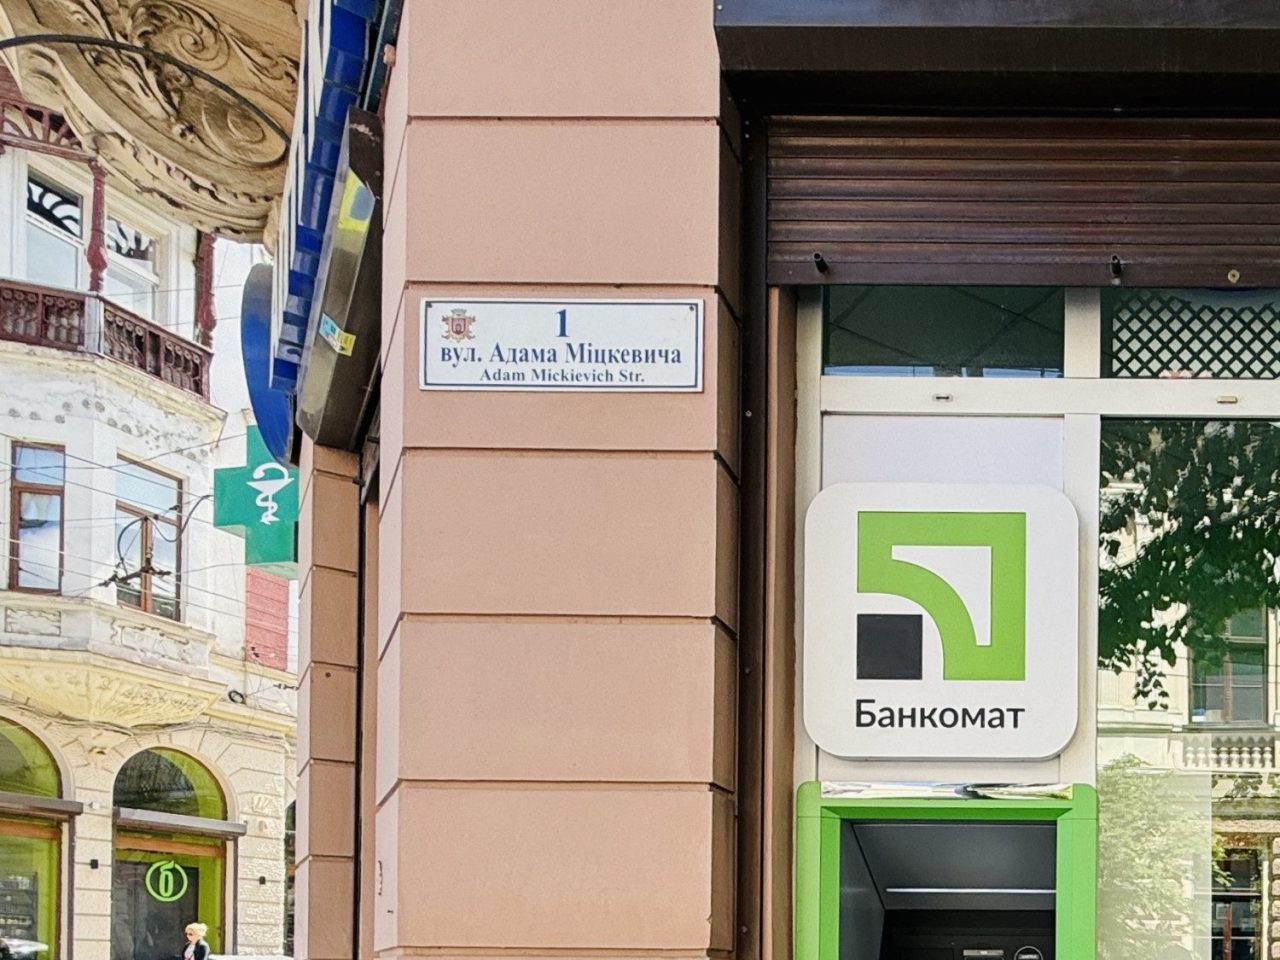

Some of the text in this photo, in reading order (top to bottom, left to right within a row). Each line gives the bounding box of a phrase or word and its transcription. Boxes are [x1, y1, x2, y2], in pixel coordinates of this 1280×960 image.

[556, 309, 569, 337] 1
[440, 342, 682, 368] вул. Адама Міцкевича
[479, 369, 645, 383] Adam Mickievich Str.
[856, 698, 1025, 729] Банкомат
